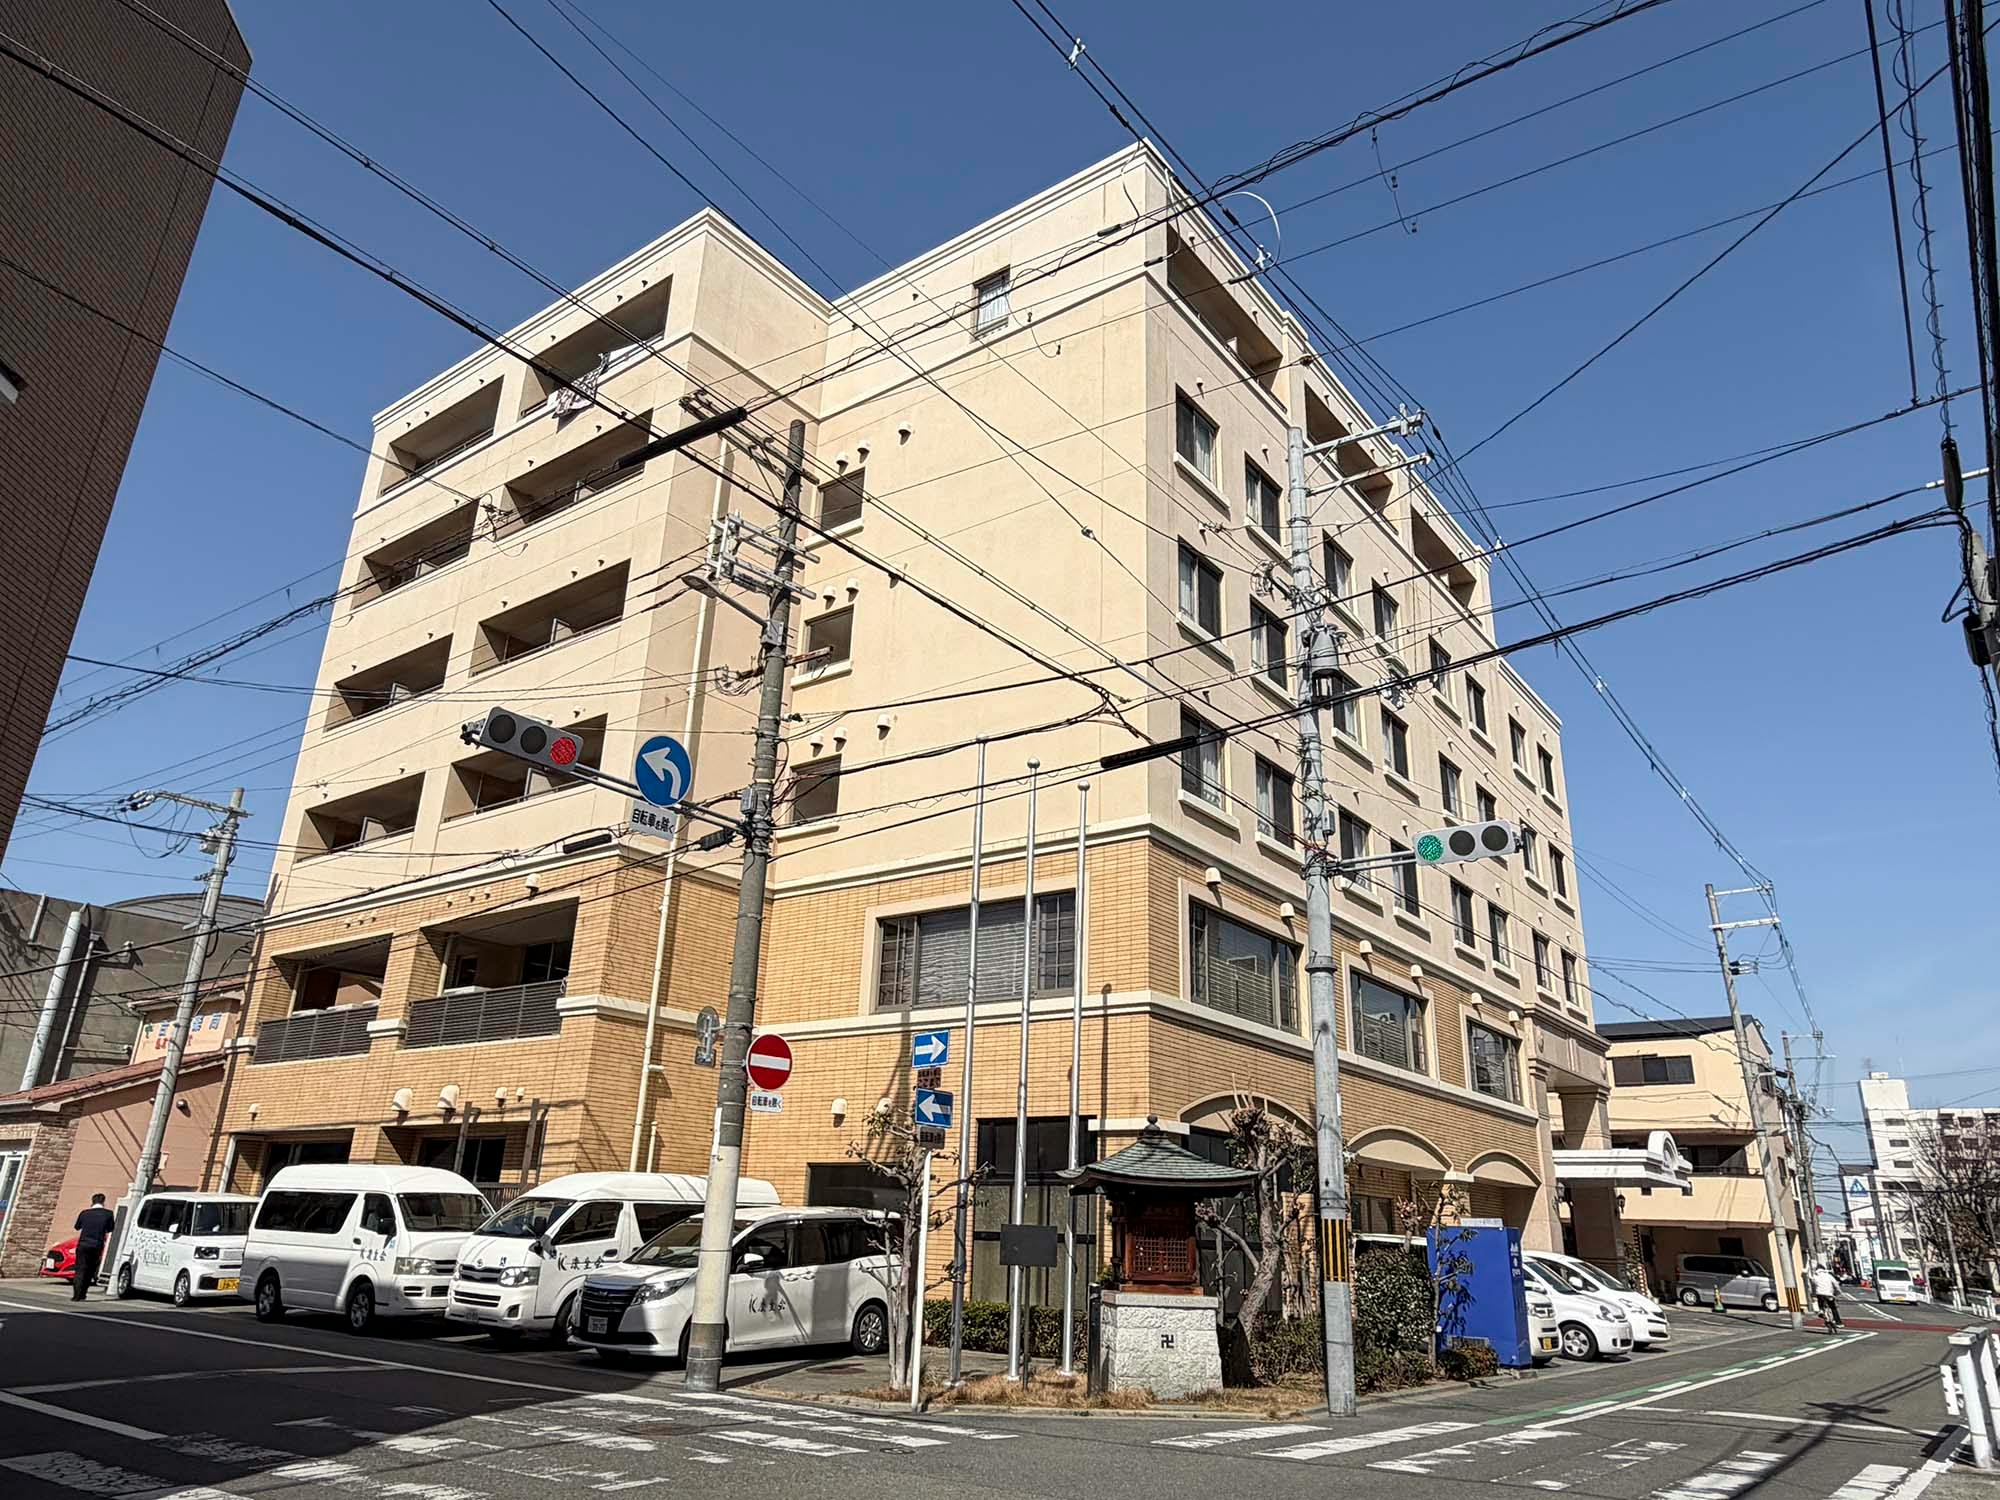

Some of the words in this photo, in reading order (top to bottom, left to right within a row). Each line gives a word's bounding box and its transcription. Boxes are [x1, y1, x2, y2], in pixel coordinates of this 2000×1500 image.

[631, 808, 675, 834] 自転車を除く
